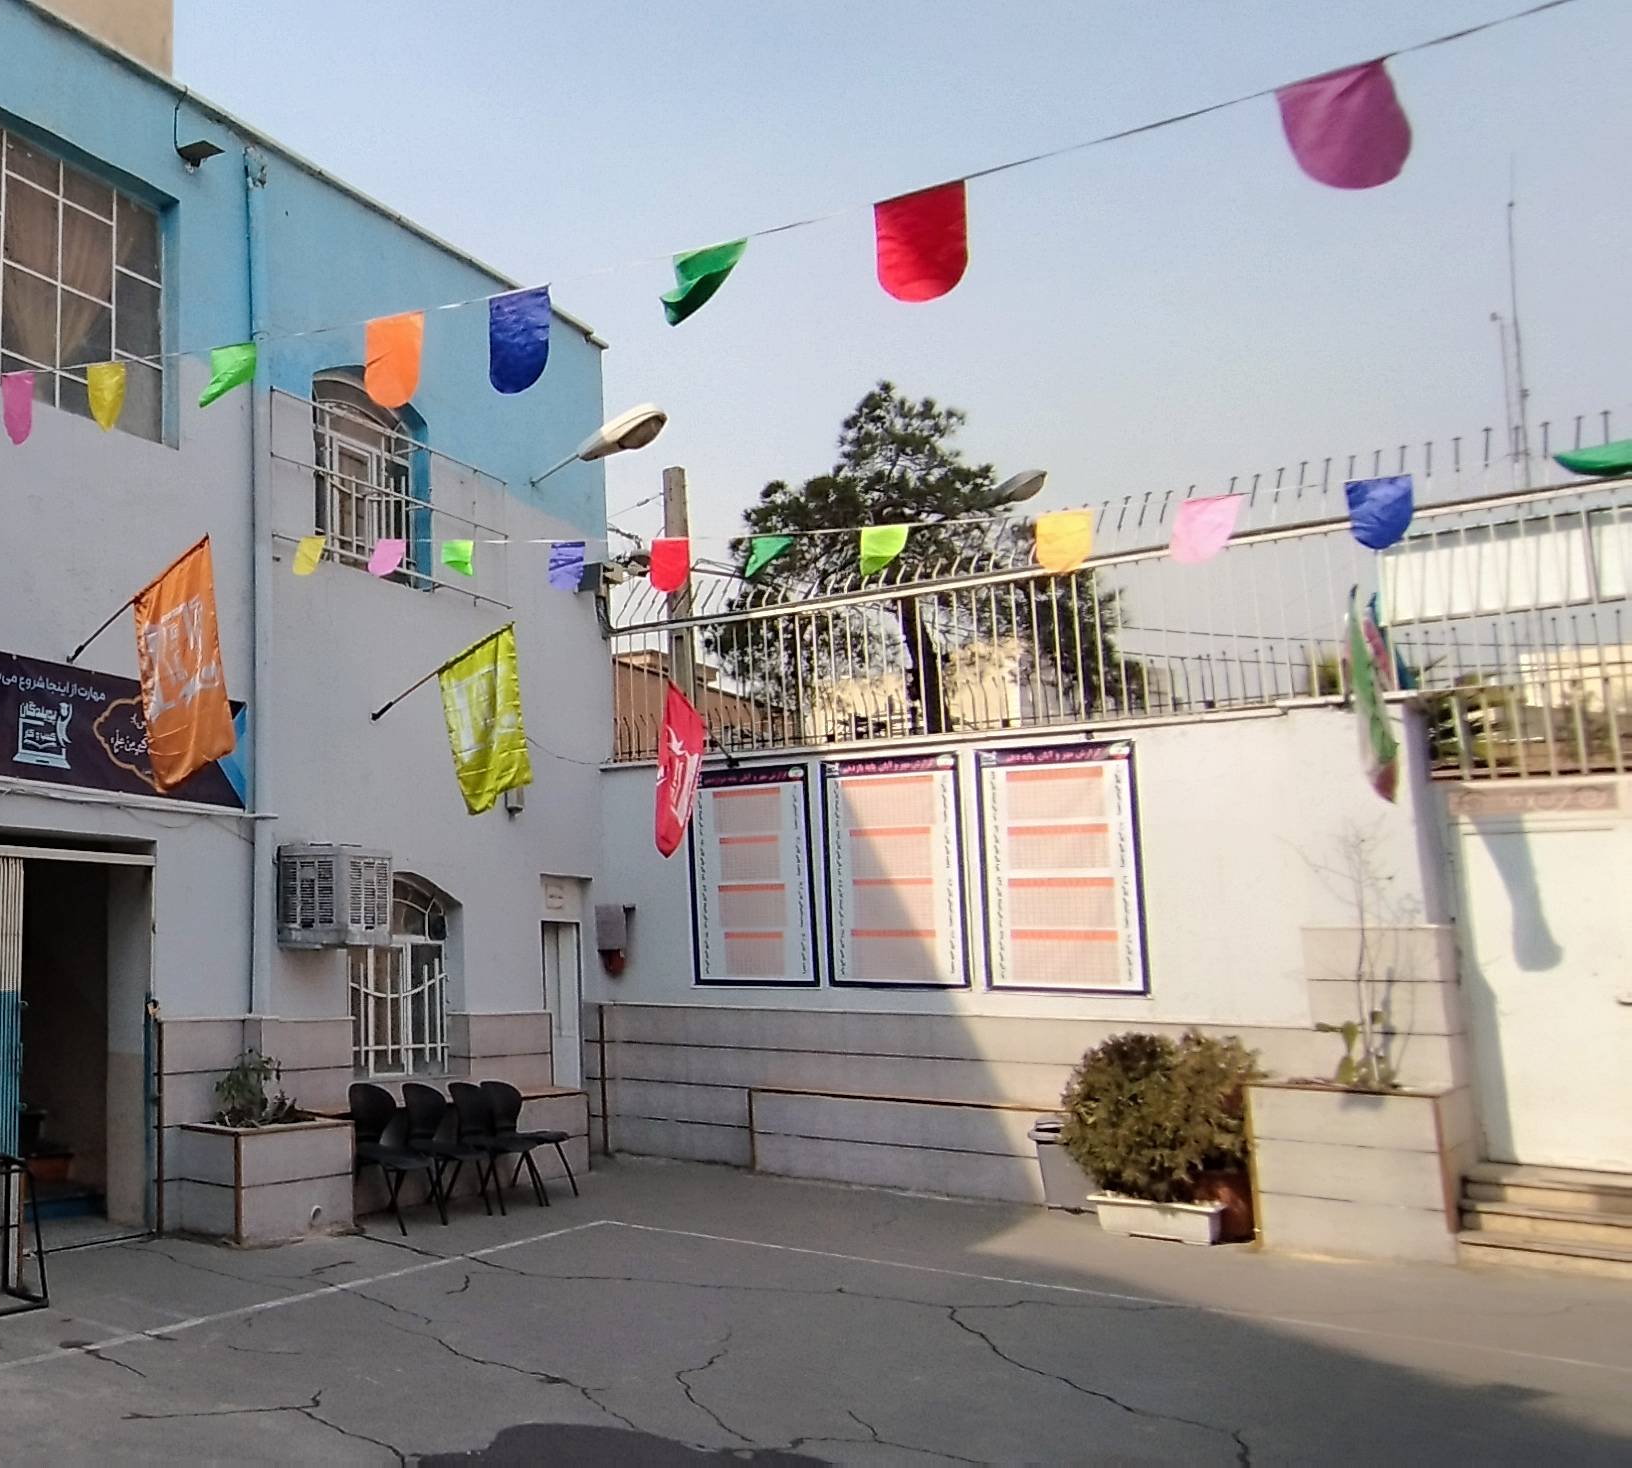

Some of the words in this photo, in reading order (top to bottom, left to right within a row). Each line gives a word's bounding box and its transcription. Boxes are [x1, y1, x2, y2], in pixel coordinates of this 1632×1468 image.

[18, 675, 46, 692] شروع
[46, 677, 70, 697] اینجا
[68, 682, 78, 697] از
[77, 685, 106, 701] مهارت
